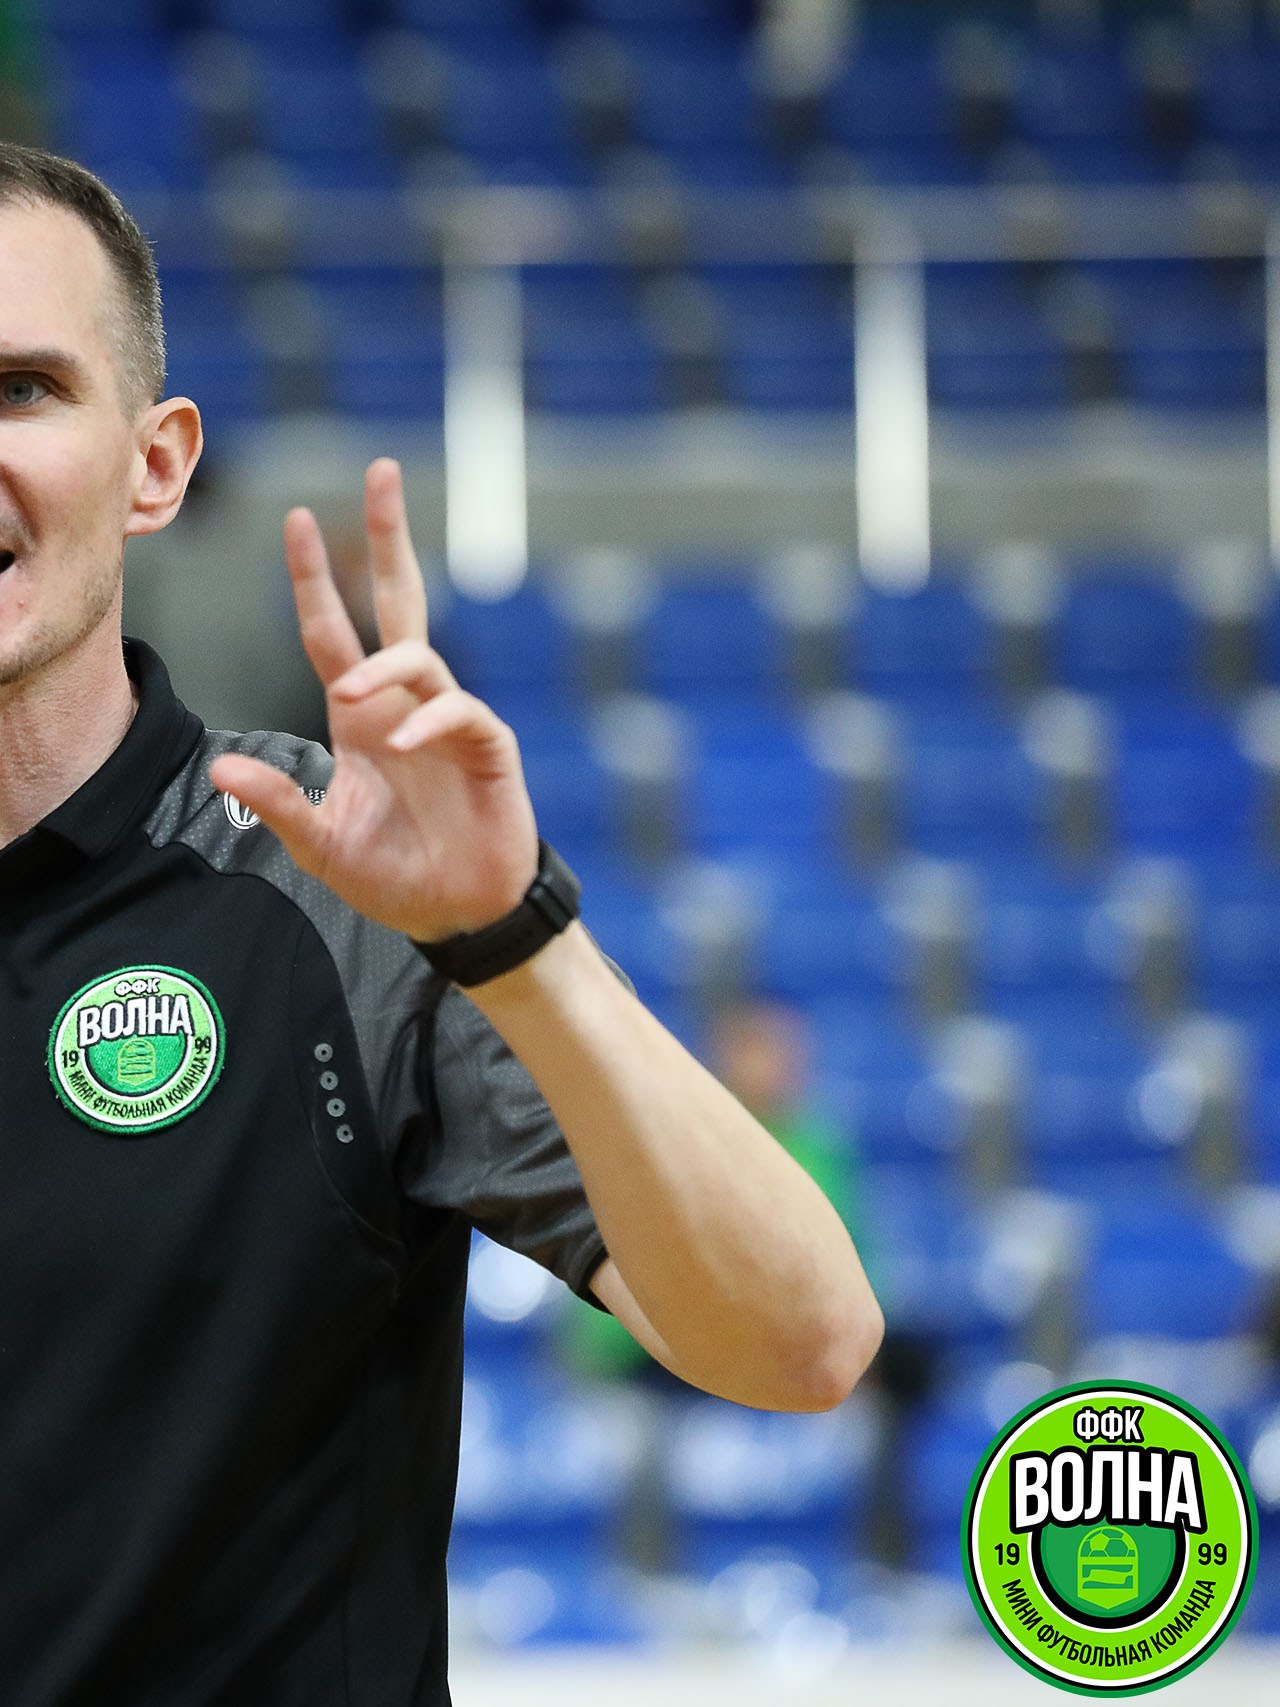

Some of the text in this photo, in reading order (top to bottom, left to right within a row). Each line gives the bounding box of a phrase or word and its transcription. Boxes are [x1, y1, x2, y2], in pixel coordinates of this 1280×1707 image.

[115, 978, 160, 996] ФФК
[79, 995, 193, 1047] ВОЛНА
[194, 1036, 211, 1054] 99
[61, 1050, 79, 1068] 19
[69, 1056, 208, 1119] МИНИ ФУТБОЛЬНАЯ КОМАНДА
